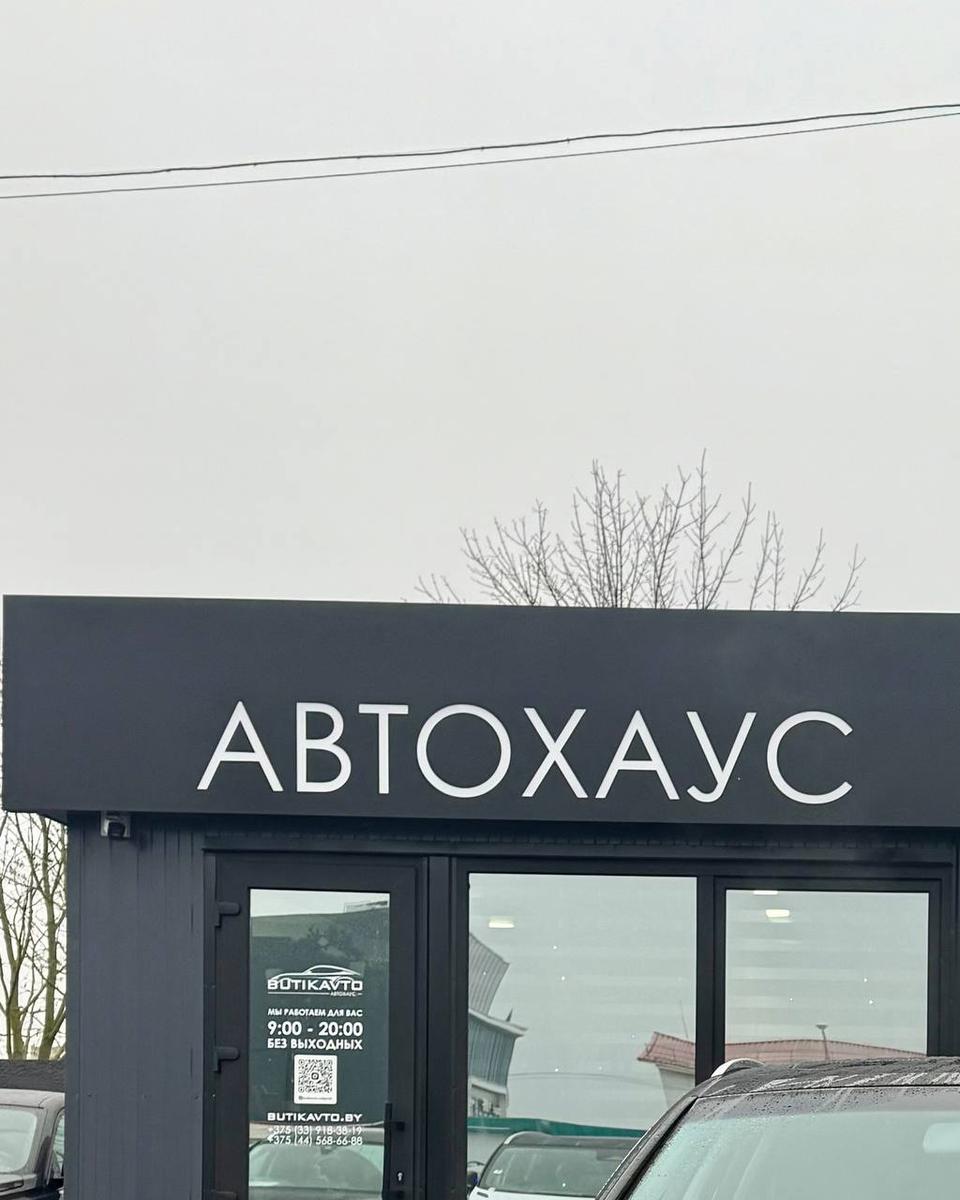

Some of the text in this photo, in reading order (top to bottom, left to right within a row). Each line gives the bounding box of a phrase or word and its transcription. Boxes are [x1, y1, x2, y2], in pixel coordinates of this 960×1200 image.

[197, 701, 854, 805] АВТОХАУС
[267, 978, 363, 991] BUTIKAVTO
[267, 1008, 363, 1018] МЫ РАБОТАЕМ ДЛЯ ВАС
[267, 1021, 302, 1036] 9:00
[318, 1022, 363, 1036] 20:00
[267, 1038, 363, 1050] БЕЗ ВЫХОДНЫХ
[267, 1112, 363, 1122] BUTIKAVTO.BY
[294, 1125, 313, 1136] (33)
[315, 1126, 362, 1135] 918-38-19
[267, 1135, 363, 1146] +375 (44) 568-66-88
